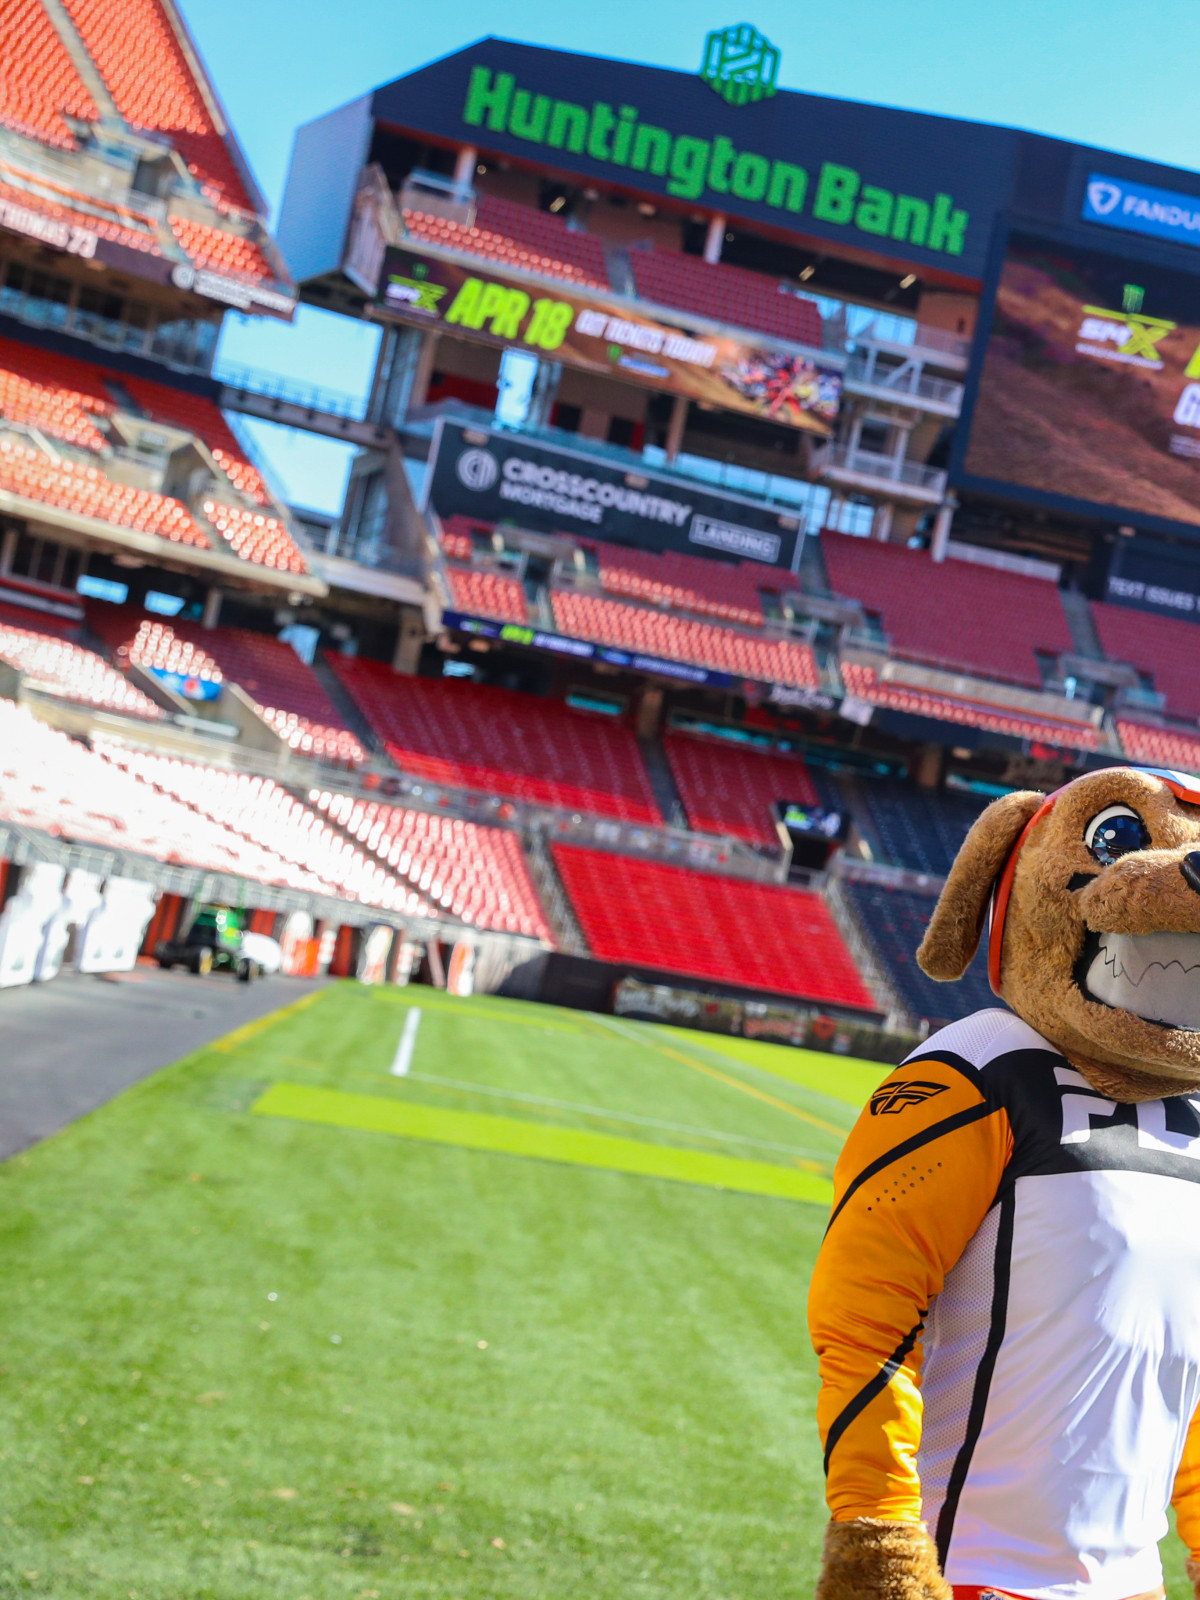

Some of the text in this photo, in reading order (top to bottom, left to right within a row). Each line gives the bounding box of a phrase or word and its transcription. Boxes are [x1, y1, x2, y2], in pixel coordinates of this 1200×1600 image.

[463, 65, 970, 255] Huntington Bank
[445, 277, 531, 340] APR
[524, 298, 574, 350] 18
[500, 480, 602, 523] MORTGAGE
[503, 457, 692, 527] CROSSCOUNTRY
[1109, 576, 1146, 599] TEXT
